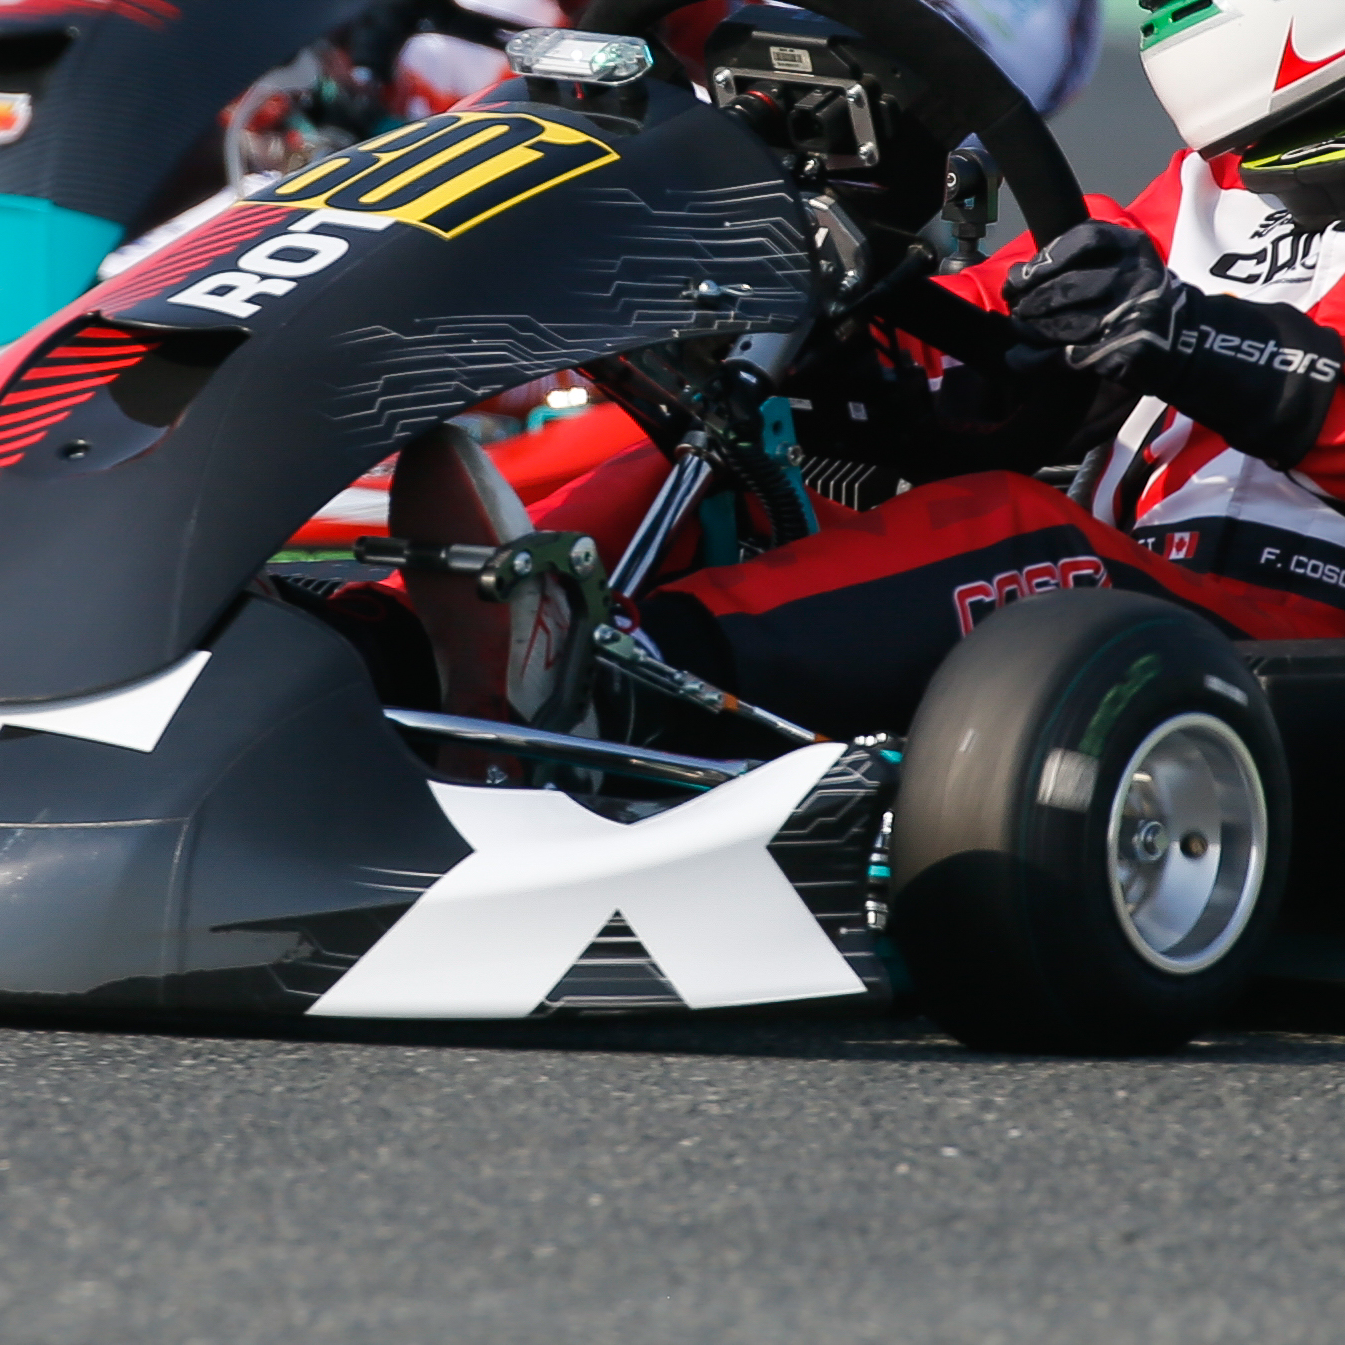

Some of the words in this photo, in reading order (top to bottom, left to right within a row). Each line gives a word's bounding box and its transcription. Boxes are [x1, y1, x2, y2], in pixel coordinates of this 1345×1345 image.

[246, 113, 611, 233] 801
[954, 555, 1113, 639] COSC
[1260, 547, 1284, 569] F.
